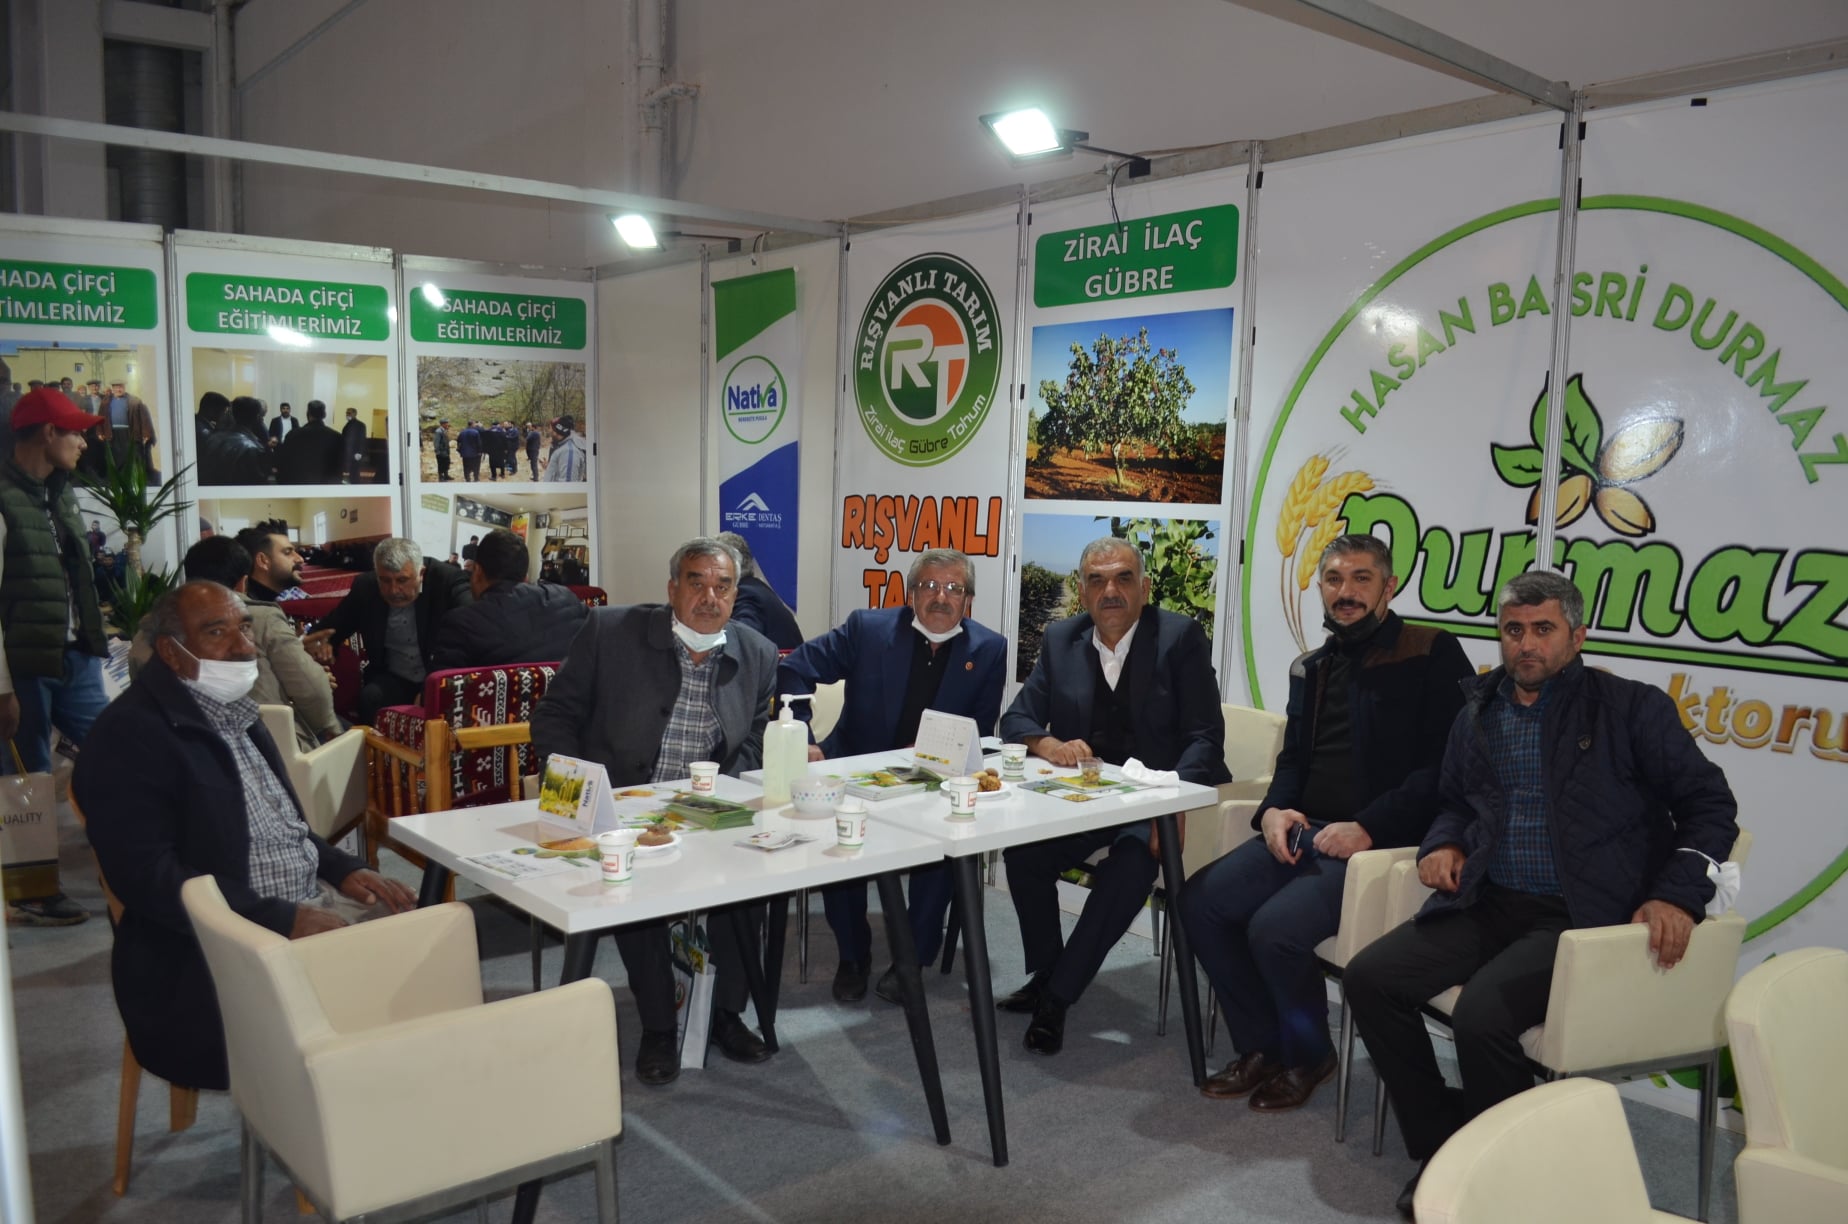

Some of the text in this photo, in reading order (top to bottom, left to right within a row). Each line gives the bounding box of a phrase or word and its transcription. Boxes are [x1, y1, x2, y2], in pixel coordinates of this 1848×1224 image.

[1063, 220, 1203, 262] ZİRAİ İLAÇ
[63, 270, 116, 296] ÇİFÇİ
[224, 283, 354, 311] SAHADA ÇİFÇİ
[1085, 266, 1174, 297] GÜBRE
[442, 297, 556, 322] SAHADA ÇİFÇİ
[860, 270, 993, 371] RIŞVANLI TARIM
[437, 320, 562, 344] EĞİTİMLERİMİZ
[727, 379, 777, 411] Nativa
[1340, 296, 1476, 434] HASAN
[1653, 282, 1848, 484] DURMAZ
[909, 438, 948, 454] Gübre
[947, 395, 986, 440] Tohum
[725, 512, 757, 521] ERKE
[842, 494, 1003, 565] RIŞVANLI
[1336, 492, 1848, 662] Durmaz
[1665, 672, 1848, 763] ktoru
[1, 812, 42, 825] UALITY
